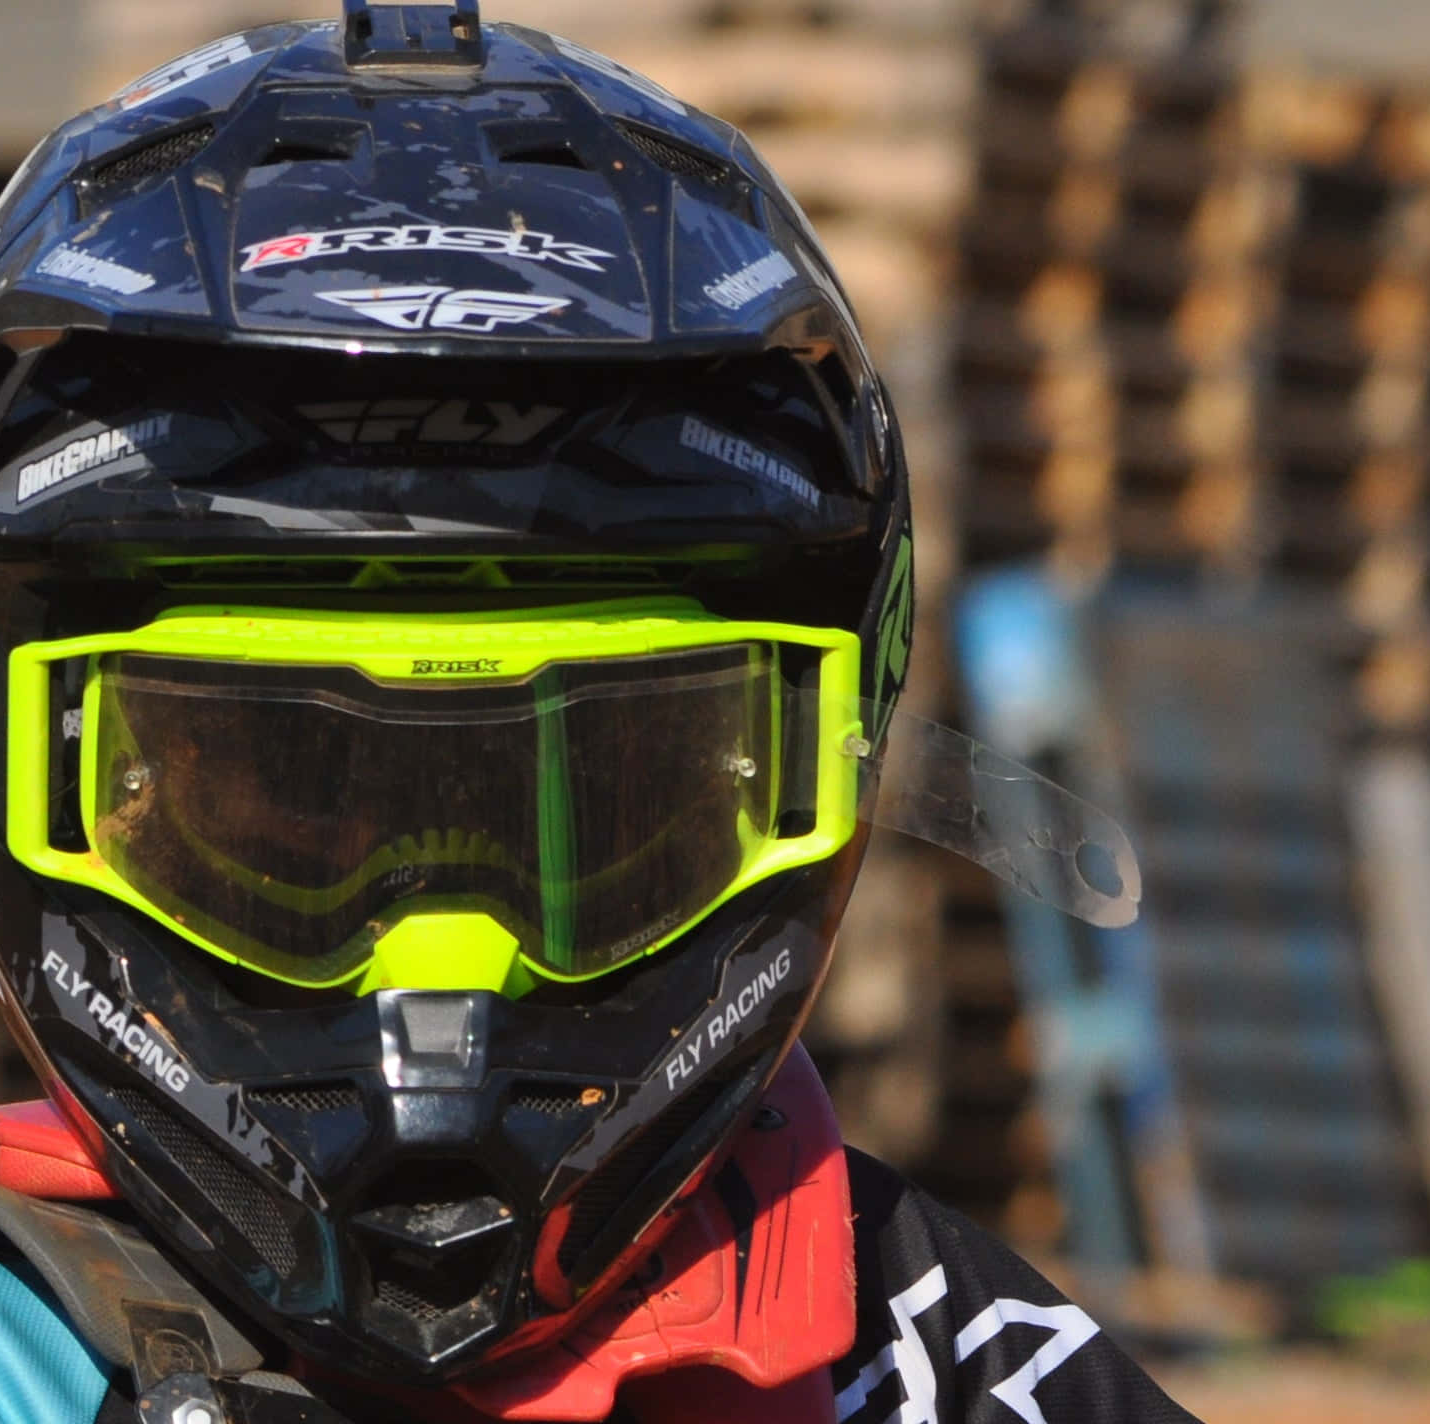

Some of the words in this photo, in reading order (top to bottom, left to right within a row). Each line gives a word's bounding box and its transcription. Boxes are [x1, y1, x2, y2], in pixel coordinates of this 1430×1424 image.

[41, 950, 93, 998] FLY
[87, 991, 191, 1093] RACING
[666, 1033, 702, 1091] FLY
[707, 947, 791, 1049] RACING
